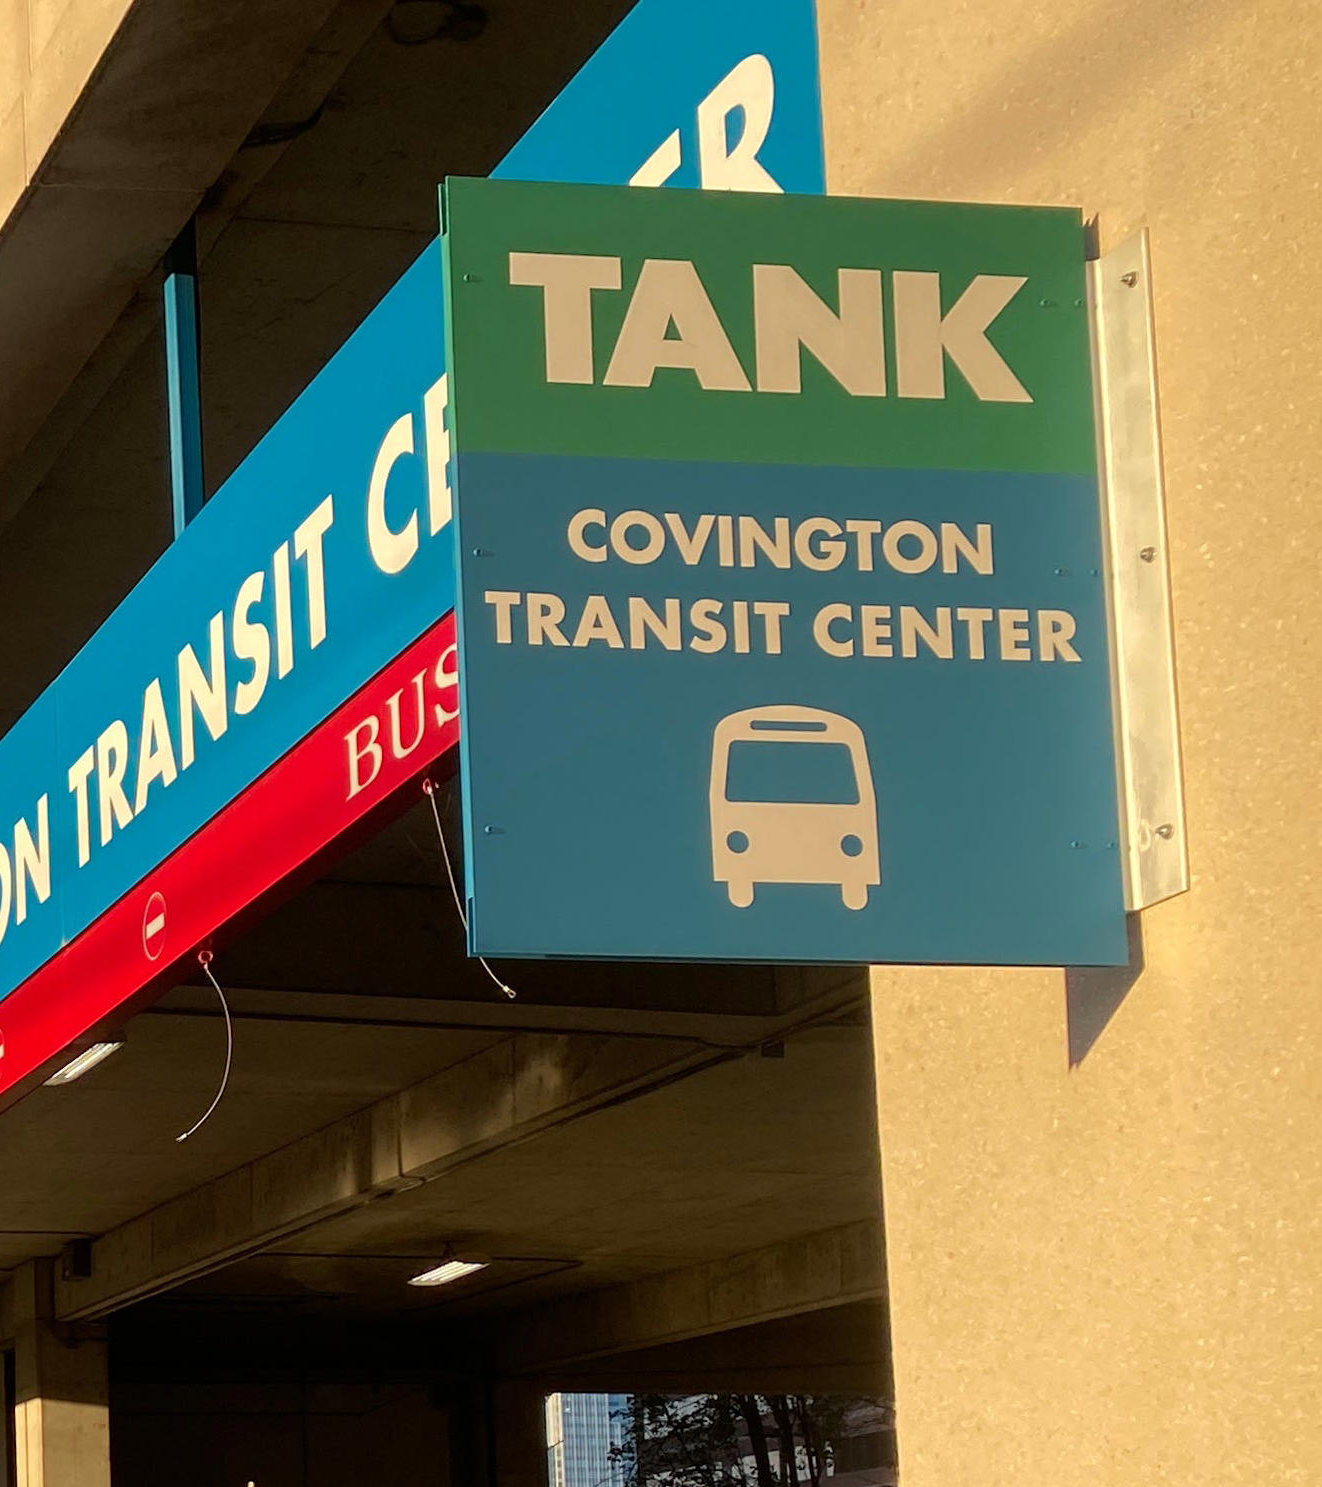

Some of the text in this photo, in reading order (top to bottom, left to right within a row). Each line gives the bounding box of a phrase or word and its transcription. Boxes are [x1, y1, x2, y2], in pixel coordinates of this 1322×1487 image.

[509, 252, 1035, 403] TANK
[567, 508, 995, 576] COVINGTON
[67, 494, 334, 868] TRANSIT
[484, 590, 1083, 663] TRANSIT CENTER
